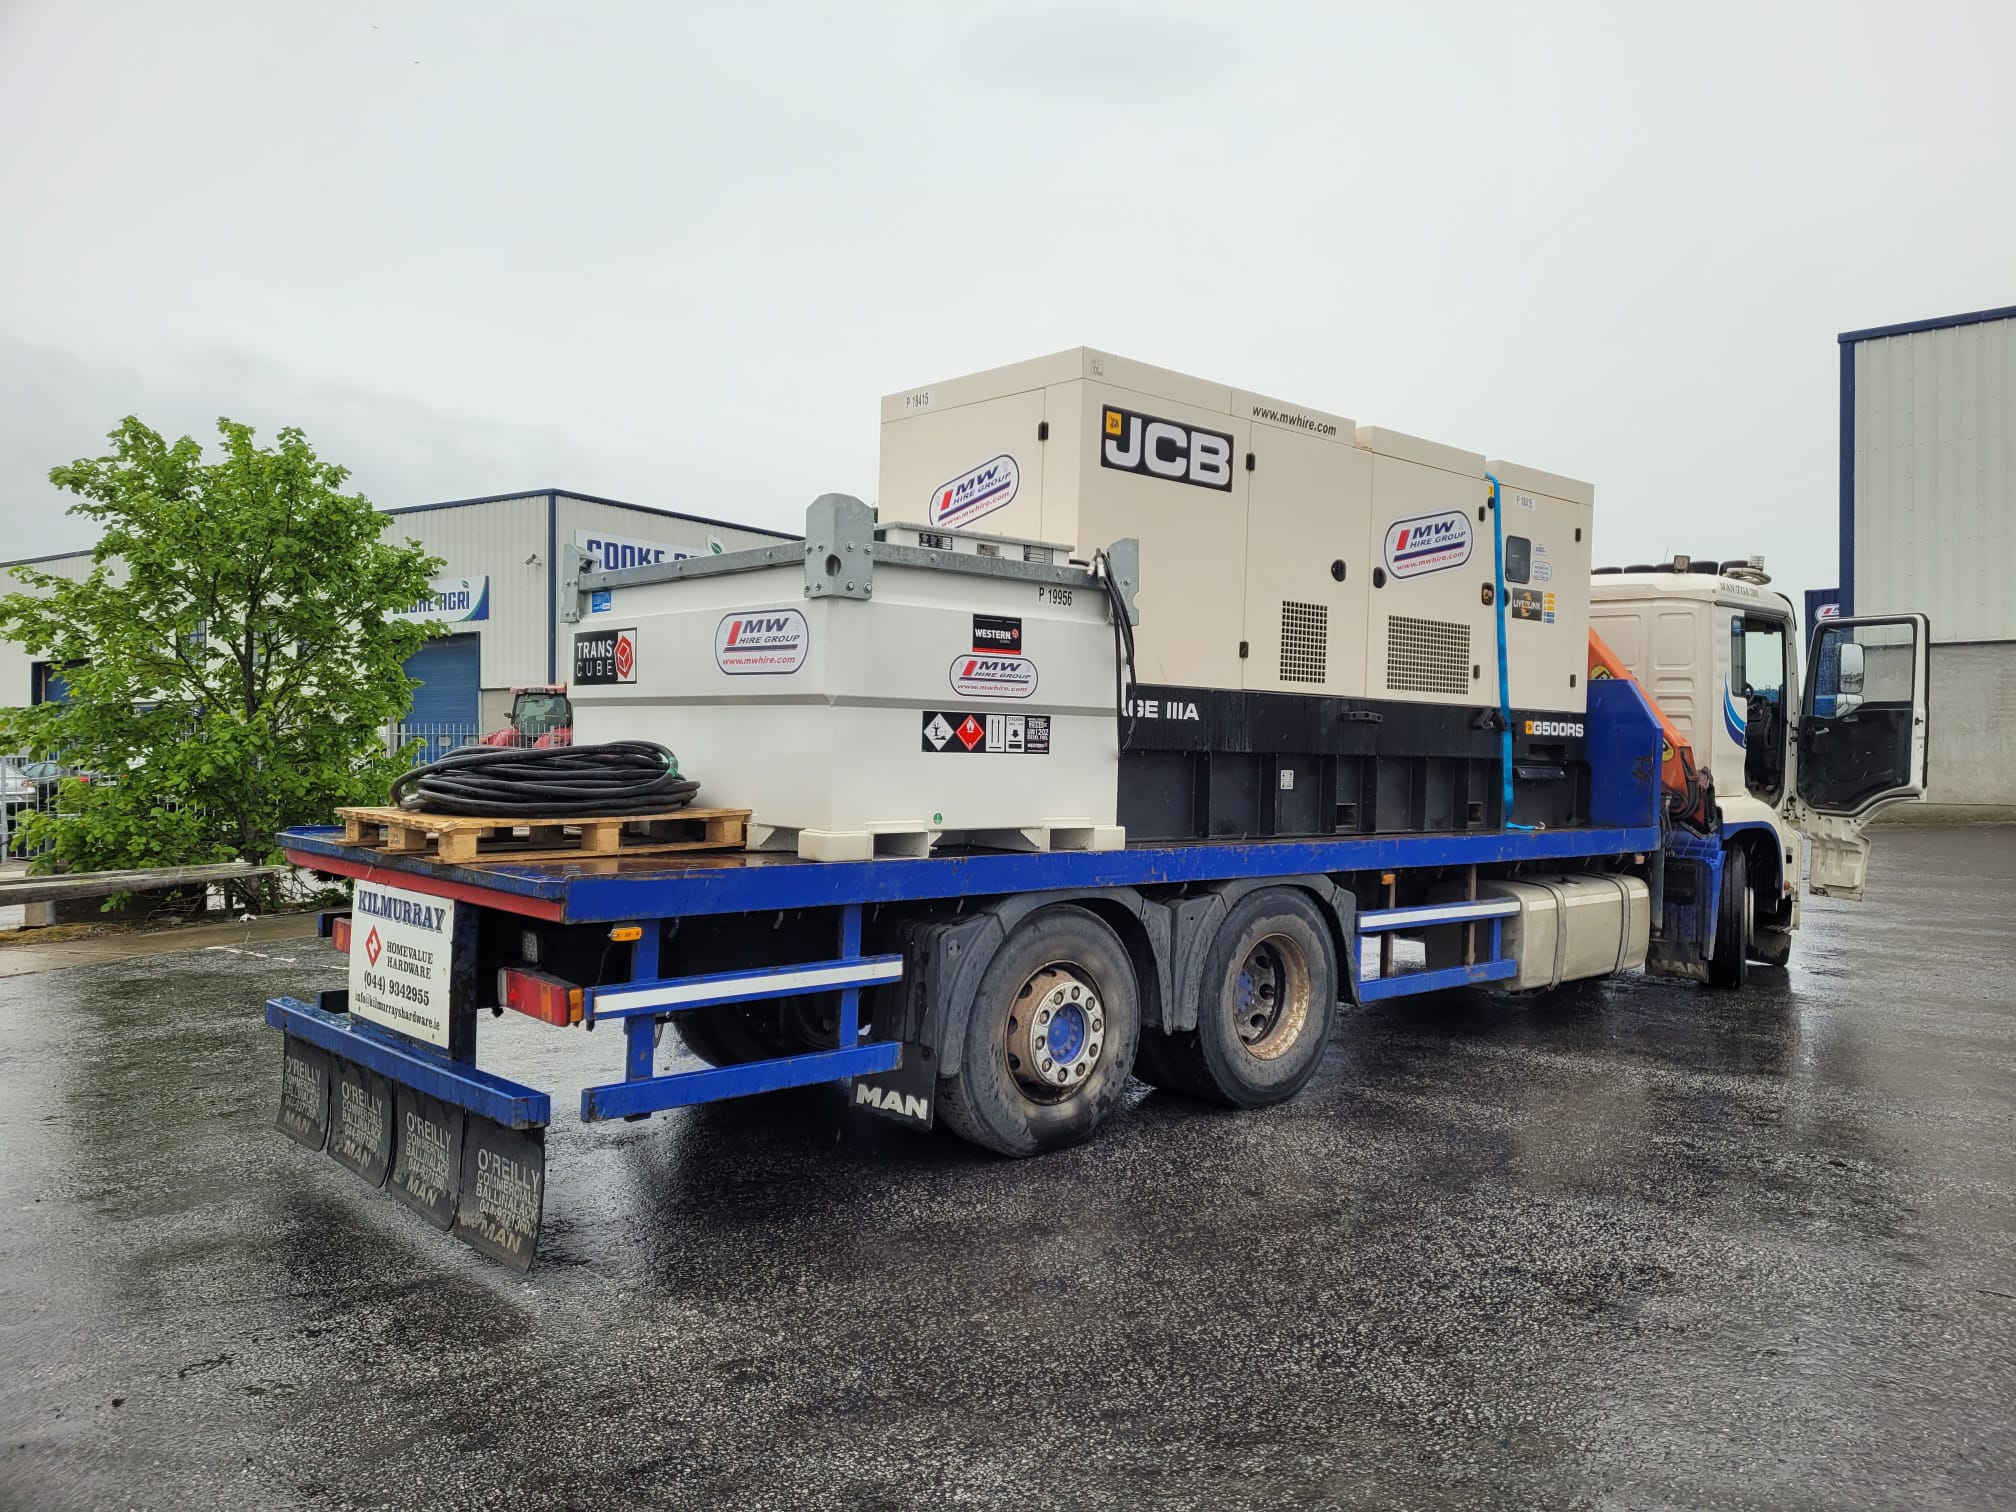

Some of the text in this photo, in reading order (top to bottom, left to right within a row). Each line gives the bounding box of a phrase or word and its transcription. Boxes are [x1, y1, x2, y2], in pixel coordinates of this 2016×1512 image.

[906, 392, 929, 409] P 18415
[1252, 405, 1337, 437] www.mwhire.com
[1104, 416, 1231, 486] JCB
[953, 471, 1012, 506] HIRE GROUP
[955, 465, 1000, 496] MW
[941, 491, 1010, 527] www.mwhire.com
[1410, 531, 1467, 549] HIRE GROUP
[1412, 520, 1456, 540] MW
[1396, 551, 1465, 571] www.mwhire.com
[439, 591, 470, 611] AGRI
[1038, 587, 1073, 606] P 19956
[738, 634, 800, 645] HIRE GROUP
[742, 617, 790, 634] MW
[975, 628, 1012, 640] WESTERN
[577, 640, 614, 659] TRANS
[722, 655, 796, 665] www.mwhire.com
[576, 659, 613, 677] CUBE
[978, 661, 1022, 672] MW
[957, 684, 1028, 692] www.mwhire.com
[1166, 701, 1200, 721] IIIA
[358, 889, 447, 933] KILMURRAY
[387, 941, 434, 965] HOMEVALUE
[387, 956, 432, 980] HARDWARE
[364, 970, 430, 1006] (044) 9342955
[354, 989, 441, 1031] info@kilmurrayshardware.ie
[285, 1055, 320, 1086] O'REILLY
[341, 1081, 382, 1118] O'REILLY
[342, 1099, 383, 1129] COMMERCIALS
[856, 1083, 928, 1120] MAN
[407, 1112, 451, 1152] O'REILLY
[343, 1140, 372, 1168] MAN
[406, 1133, 450, 1165] COMMERCIALS
[478, 1148, 541, 1193] O'REILLY
[406, 1176, 438, 1208] MAN
[476, 1183, 539, 1225] BALLINALACK
[477, 1171, 539, 1209] COMMERCIALS
[480, 1221, 522, 1255] MAN
